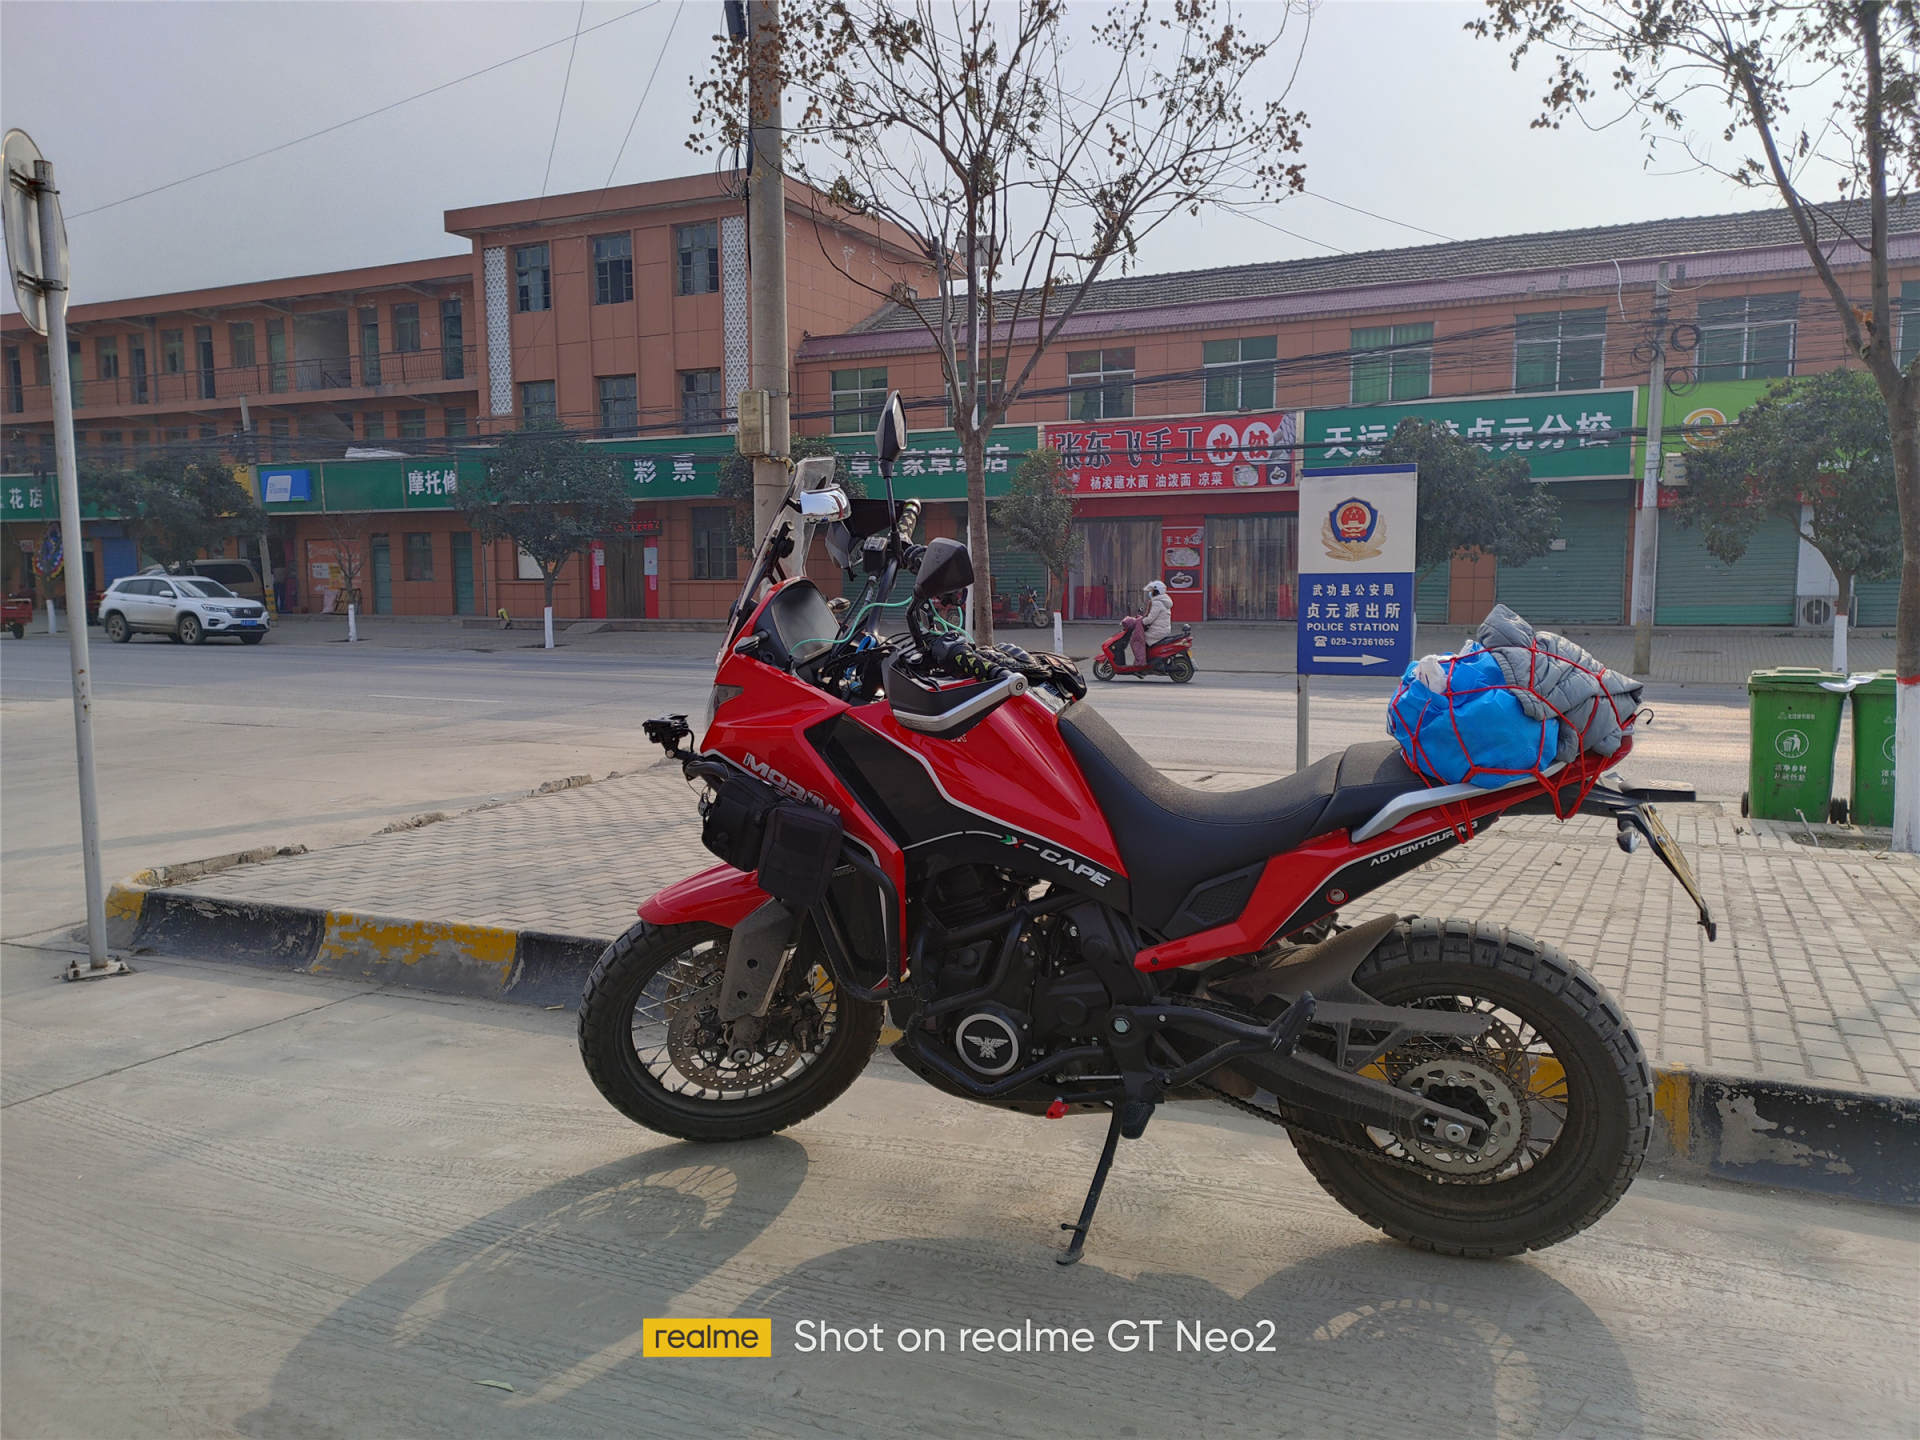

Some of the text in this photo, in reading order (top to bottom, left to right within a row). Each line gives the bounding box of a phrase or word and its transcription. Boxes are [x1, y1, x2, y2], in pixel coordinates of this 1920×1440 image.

[1055, 426, 1270, 470] 张东飞手工水饺
[1323, 411, 1613, 459] 天运贞元分校
[633, 452, 697, 484] 彩票
[834, 443, 1010, 478] 草家草店
[408, 469, 457, 496] 摩托修
[0, 487, 43, 510] 花店
[1312, 583, 1395, 597] 武功县公安局
[1306, 602, 1401, 619] 贞元派出所
[1306, 622, 1400, 632] POLICE STATION
[1330, 637, 1396, 647] 029-37361055
[1370, 820, 1479, 867] ADVENTOURNG
